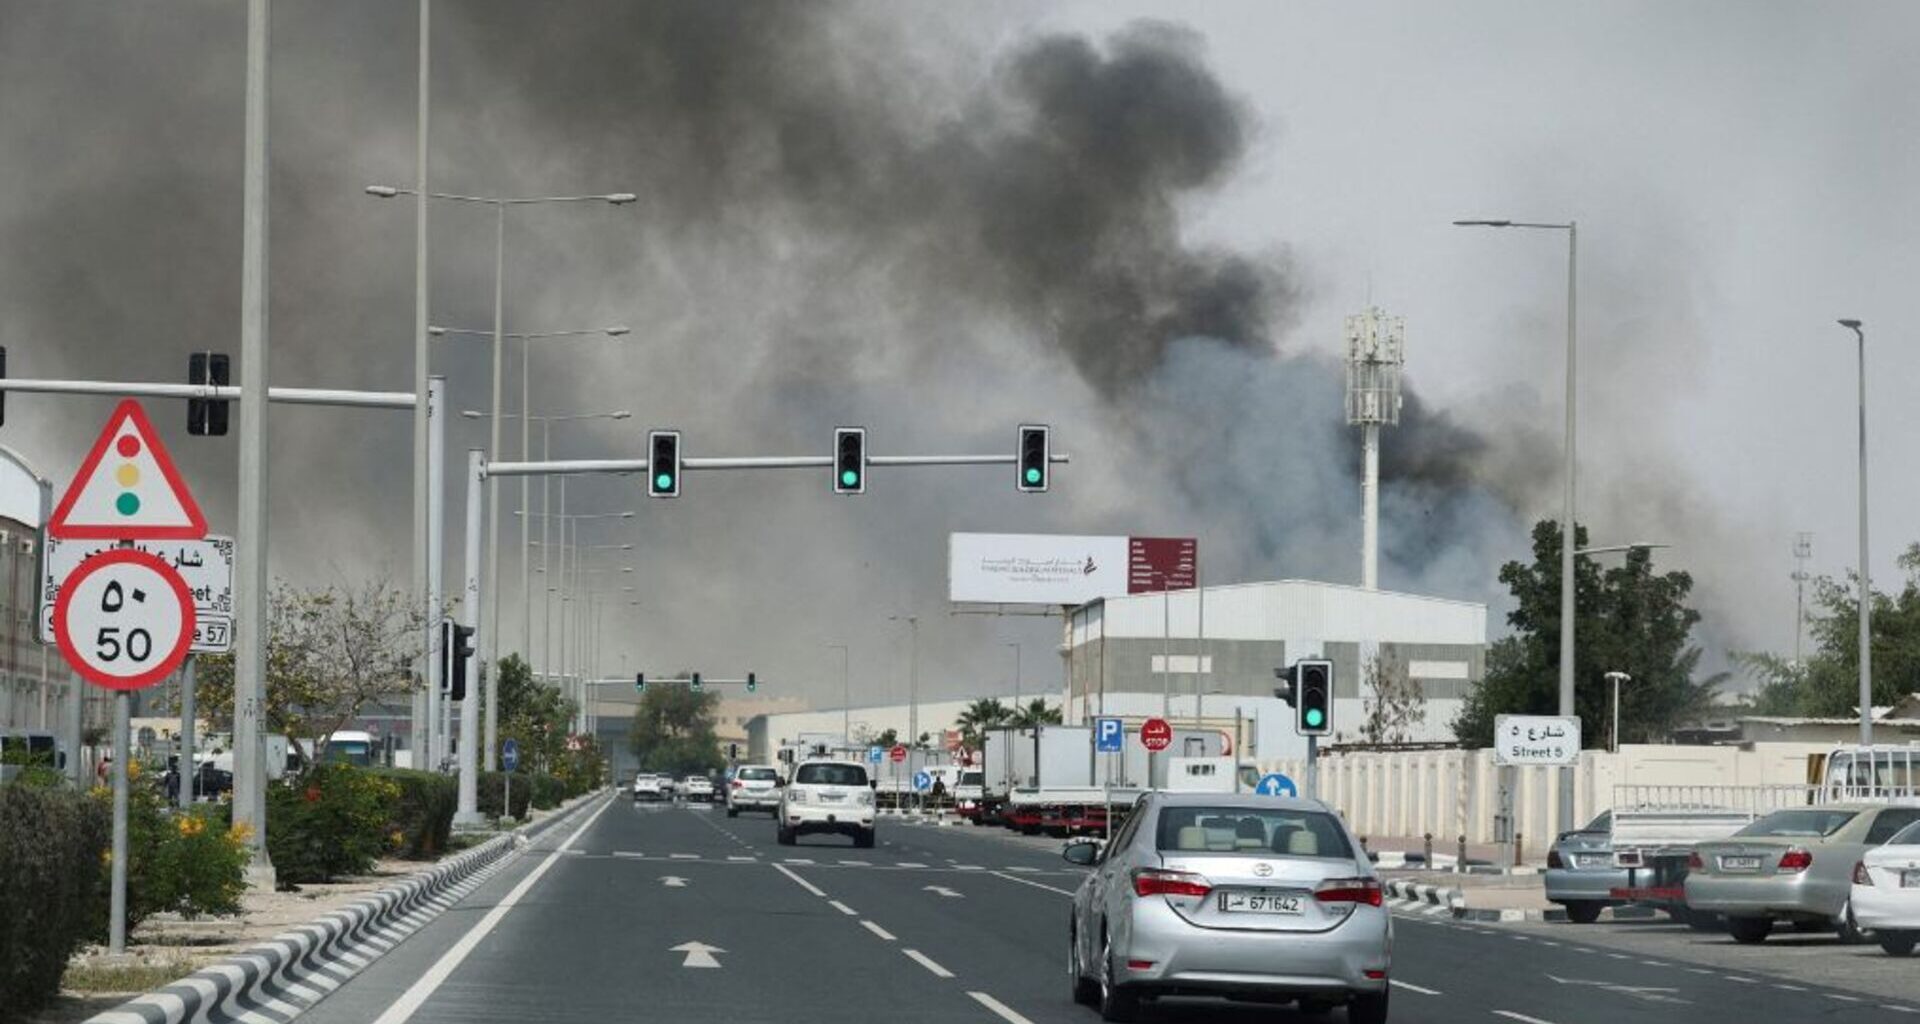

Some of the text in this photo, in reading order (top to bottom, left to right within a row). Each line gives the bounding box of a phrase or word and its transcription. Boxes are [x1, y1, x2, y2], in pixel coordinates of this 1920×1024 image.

[101, 580, 146, 612] ٥٠
[207, 627, 226, 641] 57
[96, 627, 152, 662] 50
[1102, 721, 1117, 741] P
[1511, 726, 1565, 741] شارع ٥
[1146, 738, 1169, 747] STOP
[1512, 746, 1564, 758] Street 5
[1249, 896, 1299, 911] 671642
